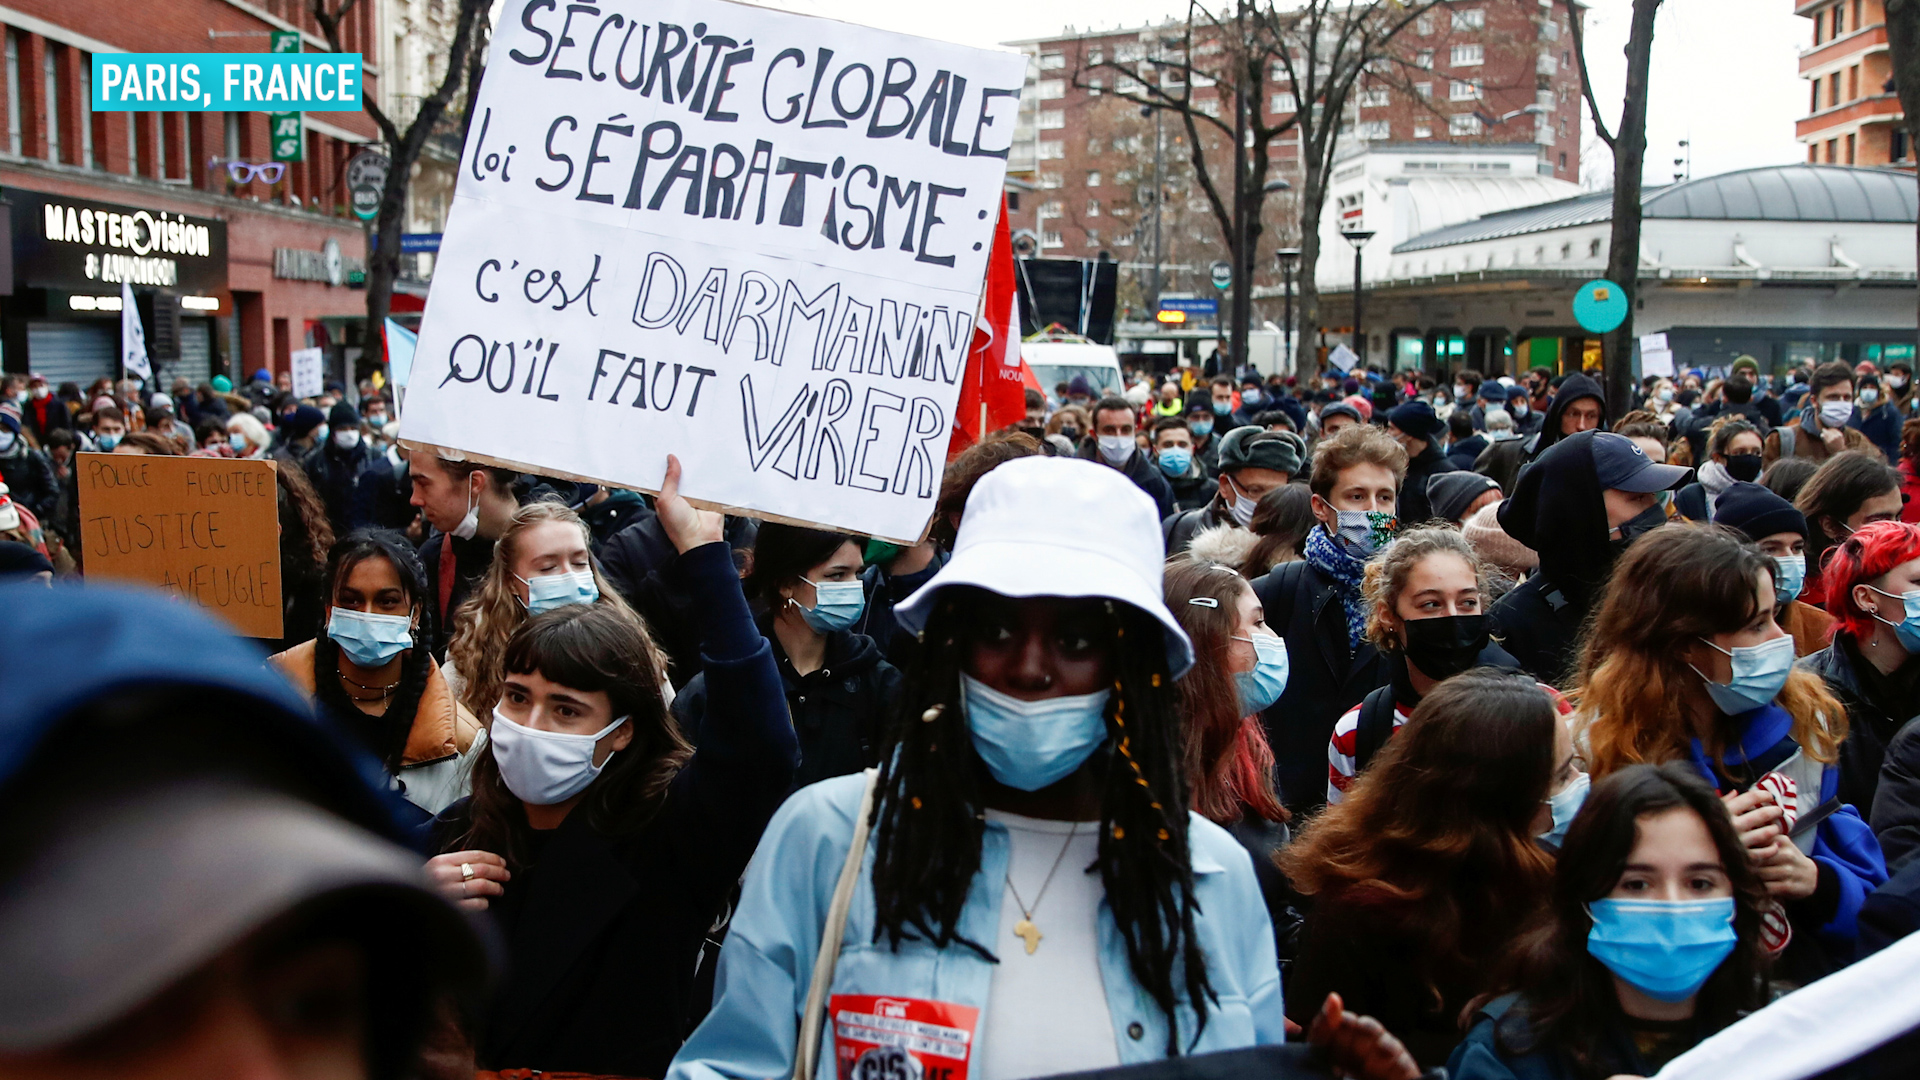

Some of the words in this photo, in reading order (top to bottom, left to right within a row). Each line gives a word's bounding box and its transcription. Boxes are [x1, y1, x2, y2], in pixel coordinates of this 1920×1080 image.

[509, 0, 754, 122] SÉCURITÉ
[762, 47, 1022, 162] GLOBALE
[472, 107, 516, 182] loi
[354, 191, 377, 205] BUS
[1212, 266, 1230, 277] BUS
[476, 254, 602, 317] c'est
[632, 252, 972, 385] DARMANIN
[439, 334, 560, 402] QU'IL
[588, 349, 717, 417] FAUT
[740, 374, 944, 498] VIRER
[89, 460, 152, 489] POLICE
[187, 471, 266, 496] FLOUTEE
[89, 511, 226, 557] JUSTICE
[159, 561, 276, 608] AVEUGLE
